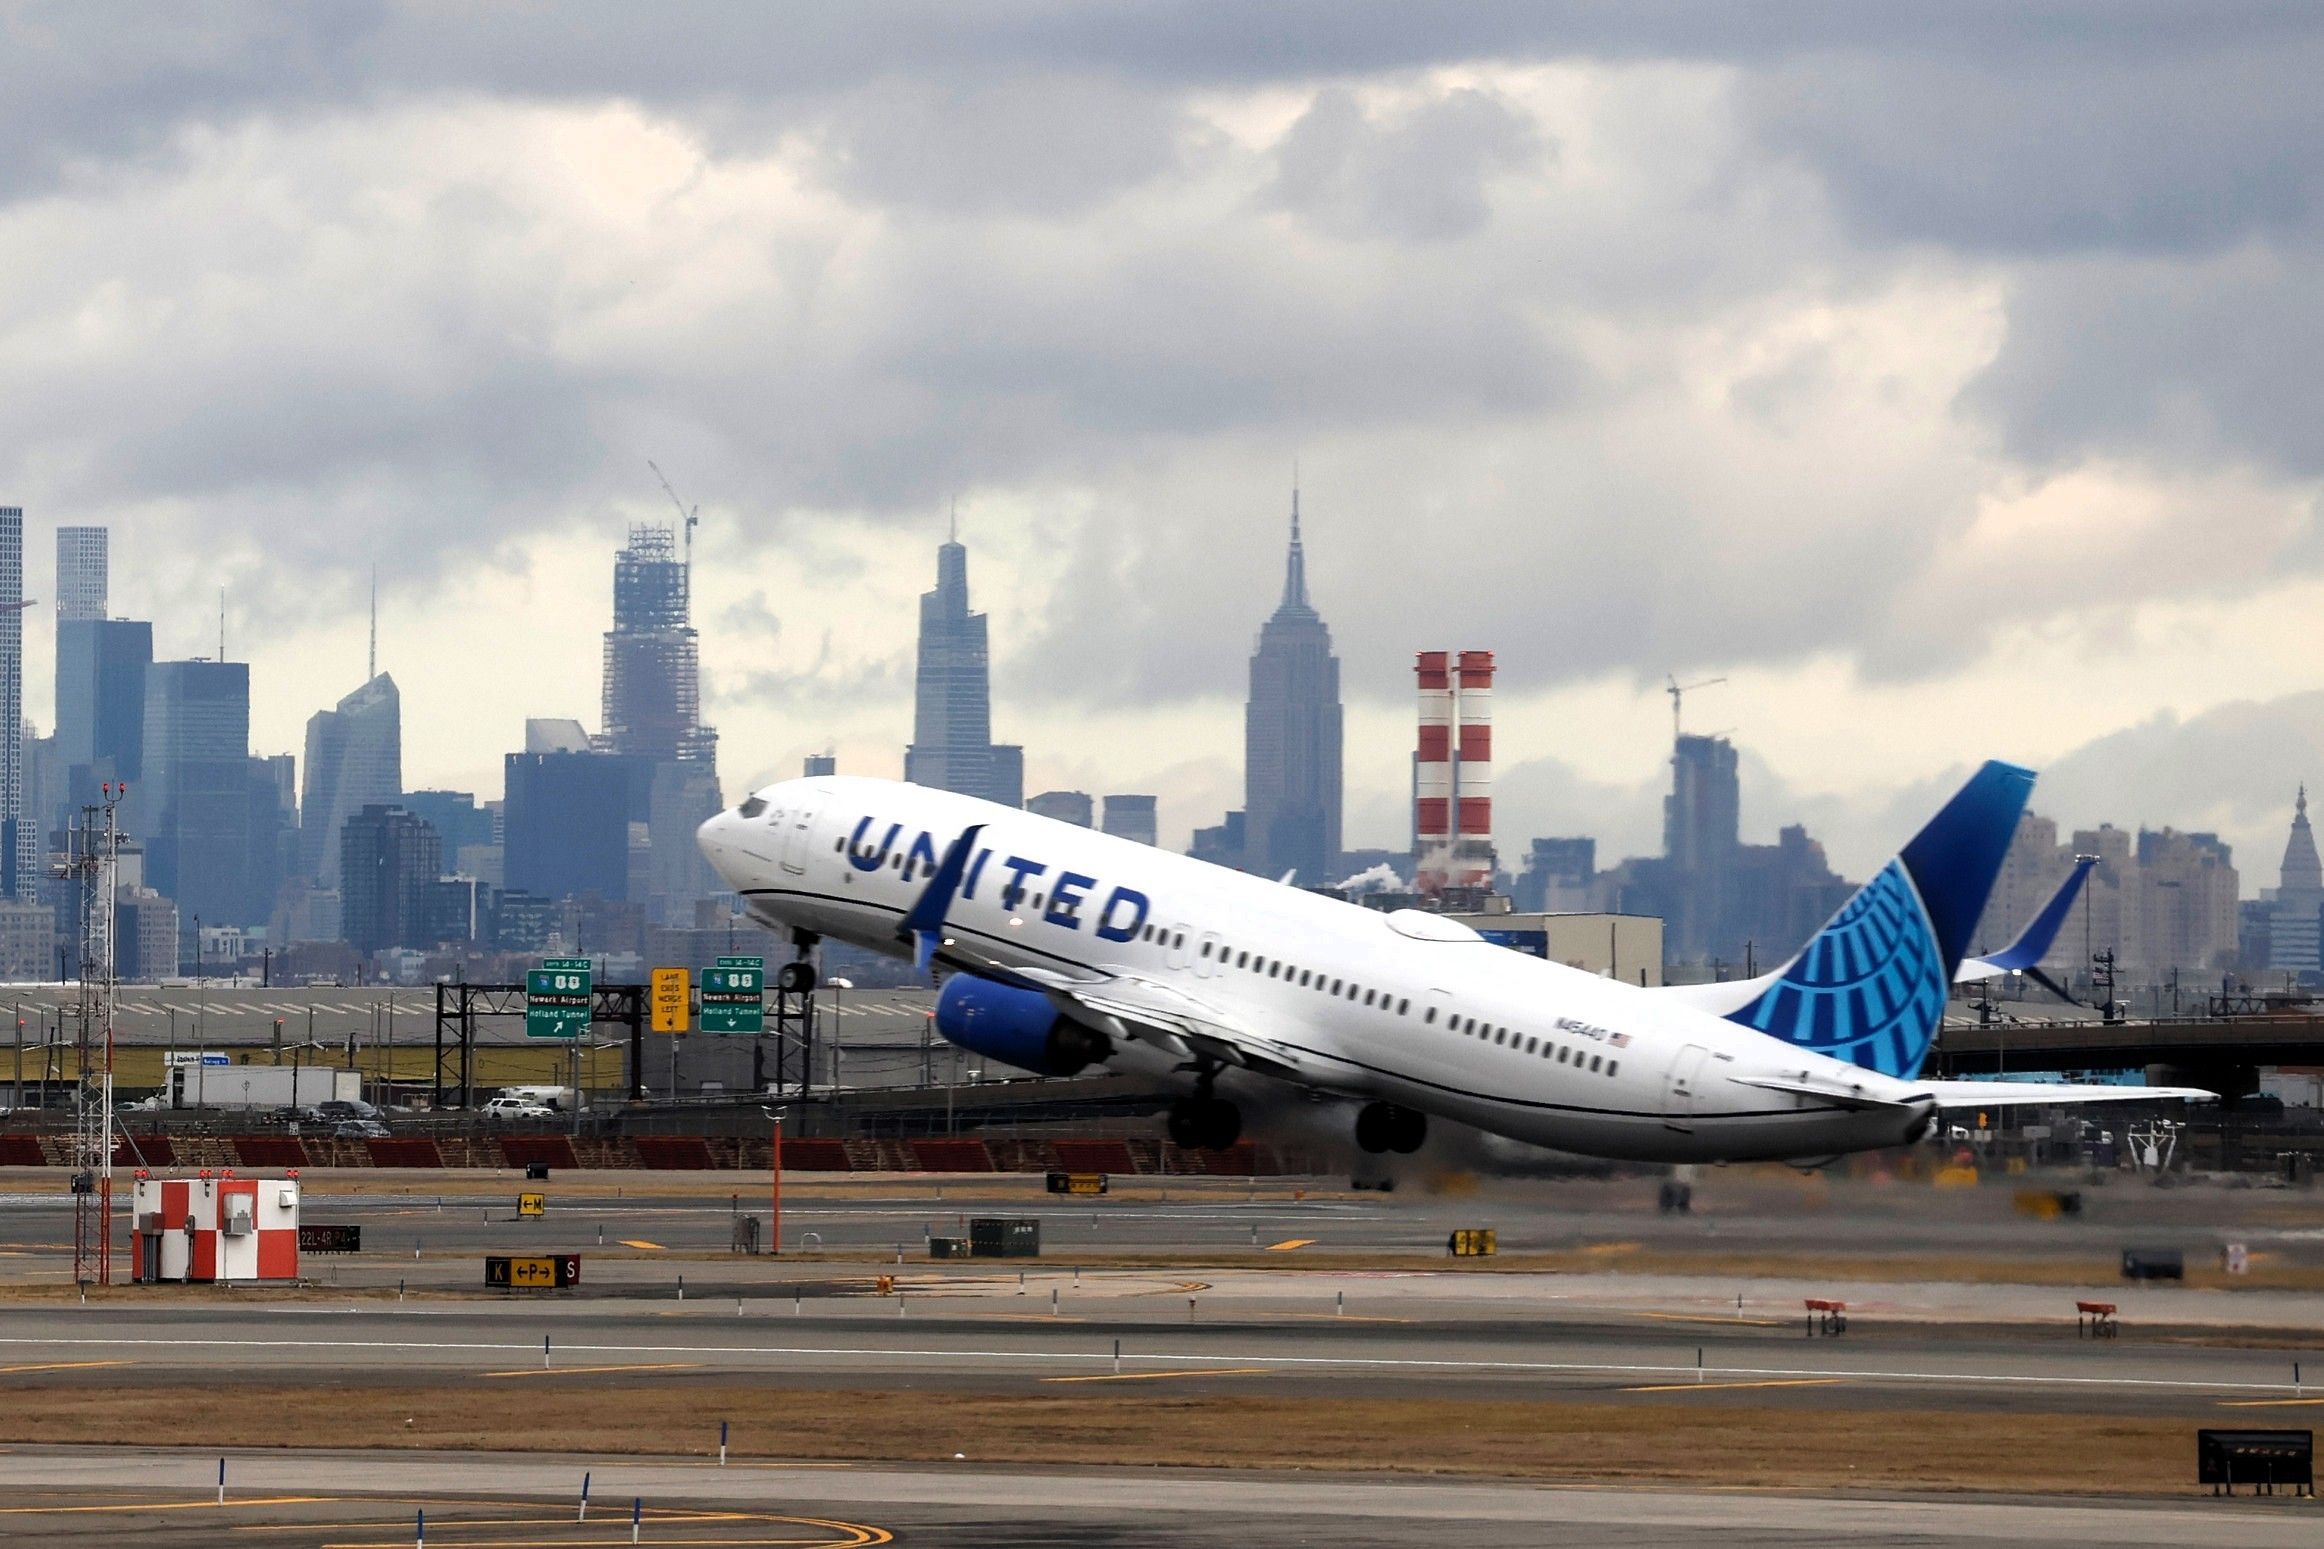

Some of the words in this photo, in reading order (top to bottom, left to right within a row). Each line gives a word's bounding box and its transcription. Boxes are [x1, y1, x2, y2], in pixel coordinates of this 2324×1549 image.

[847, 815, 1150, 943] UNITED
[529, 995, 557, 1003] Newark
[560, 995, 588, 1005] Airport
[703, 993, 730, 1001] Newark
[734, 993, 760, 1003] Airport
[529, 1010, 559, 1018] Holland
[561, 1010, 588, 1019] Tunnel
[703, 1007, 732, 1015] Holland
[533, 1198, 542, 1211] M
[494, 1263, 503, 1281] K
[529, 1263, 538, 1281] P
[566, 1261, 576, 1278] S
